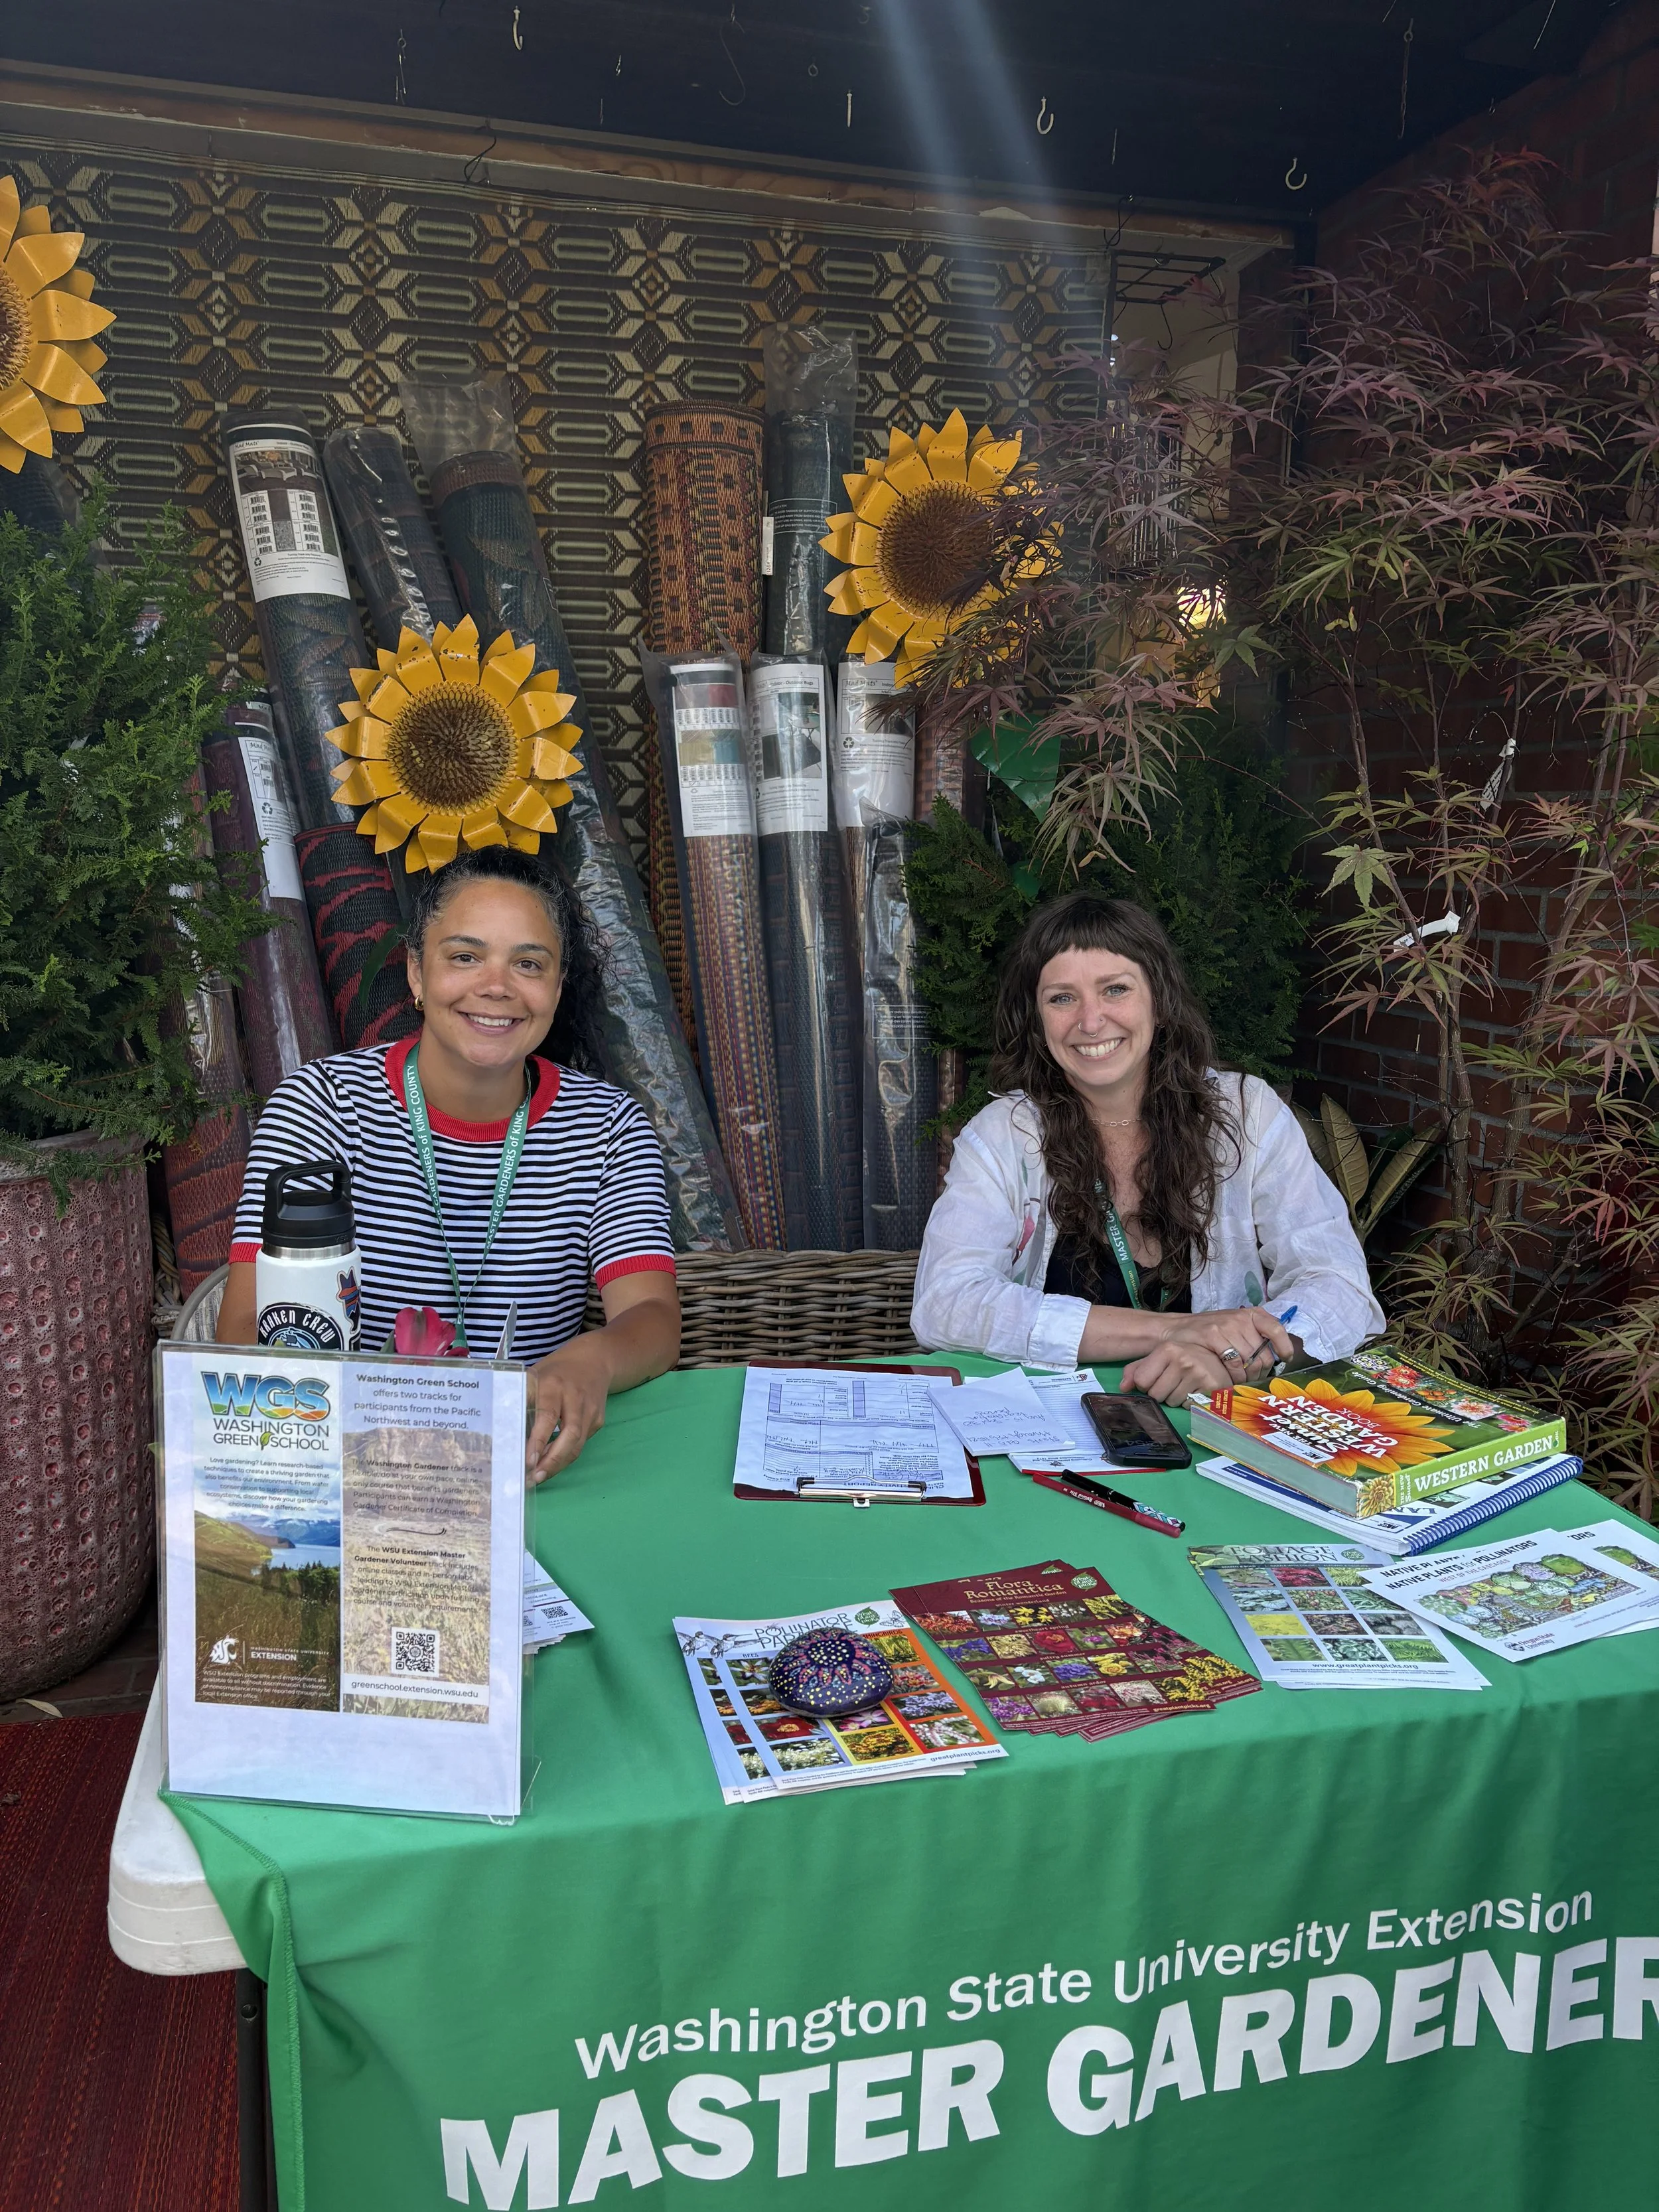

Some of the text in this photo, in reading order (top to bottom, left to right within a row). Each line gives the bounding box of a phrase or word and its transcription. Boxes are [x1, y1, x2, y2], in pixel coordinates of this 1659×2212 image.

[512, 1110, 524, 1134] KING
[406, 1064, 440, 1207] GARDENERS of KING COUNTY
[511, 1134, 519, 1147] of
[496, 1147, 517, 1208] GARDENERS
[486, 1210, 502, 1250] MASTER
[1109, 1226, 1129, 1261] MASTER
[259, 1309, 335, 1343] KRAKEN CREW
[356, 1374, 479, 1388] Washington Green School
[200, 1371, 331, 1422] WGS
[420, 1392, 447, 1401] tracks
[1351, 1371, 1481, 1429] The Ultimate Gardening Guide
[354, 1402, 481, 1416] participants from the Pacific
[1336, 1408, 1382, 1428] BOOK
[213, 1418, 329, 1437] WASHINGTON
[364, 1416, 469, 1430] Northwest and beyond.
[1258, 1394, 1387, 1458] WESTERN
[1287, 1395, 1398, 1446] GARDEN
[213, 1433, 329, 1451] GREEN SCHOOL
[1009, 1430, 1050, 1439] through
[1259, 1413, 1349, 1453] Sunset
[1269, 1423, 1313, 1447] THE NEW
[225, 1458, 259, 1467] gardening?
[366, 1459, 412, 1469] Washington
[1414, 1455, 1488, 1492] WESTERN
[1493, 1435, 1553, 1467] GARDEN
[402, 1548, 438, 1557] Extension
[1228, 1546, 1334, 1554] FOLIAGE
[1236, 1554, 1338, 1562] FASHION
[354, 1555, 389, 1564] Gardener
[390, 1558, 427, 1566] Volunteer
[1386, 1574, 1425, 1589] NATIVE
[1426, 1564, 1464, 1582] PLANTS
[1473, 1540, 1538, 1564] POLLINATORS
[1380, 1563, 1420, 1578] NATIVE
[1439, 1574, 1457, 1584] WEST
[1477, 1558, 1511, 1574] CASCADES
[964, 1583, 1064, 1599] Romantica
[985, 1579, 1034, 1590] Flora
[755, 1612, 850, 1639] POLLINATOR
[1518, 1637, 1538, 1647] Oregon
[1525, 1639, 1555, 1650] University
[251, 1652, 297, 1661] EXTENSION
[352, 1680, 478, 1698] greenschool.extension.wsu.edu
[1153, 1702, 1210, 1712] greatplantpicks.org
[930, 1747, 1001, 1762] greatplantpicks.org
[575, 1891, 1591, 2079] Washington State University Extension
[441, 2039, 1004, 2212] MASTER
